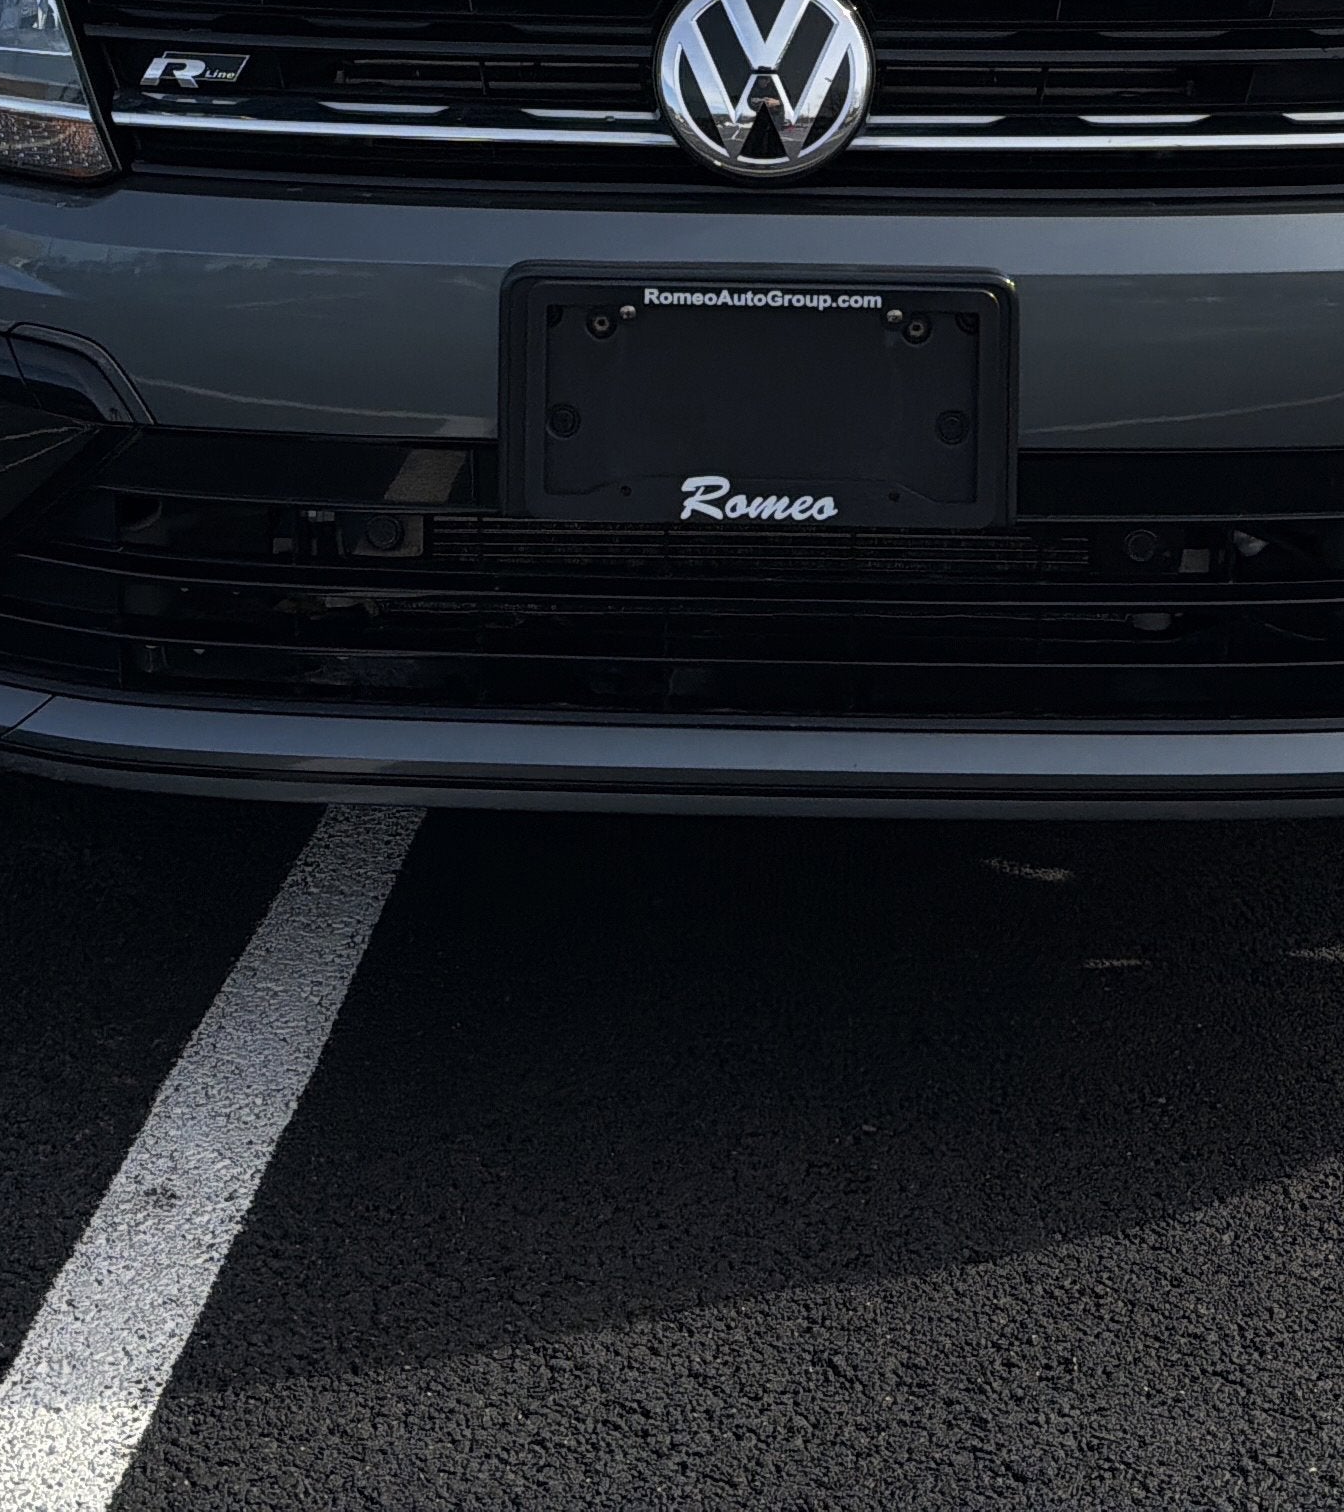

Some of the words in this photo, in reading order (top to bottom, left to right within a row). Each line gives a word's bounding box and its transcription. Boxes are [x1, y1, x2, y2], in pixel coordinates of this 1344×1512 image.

[140, 58, 206, 88] R
[644, 288, 882, 311] RomeoAutoGroup.com
[680, 475, 838, 521] Romeo
